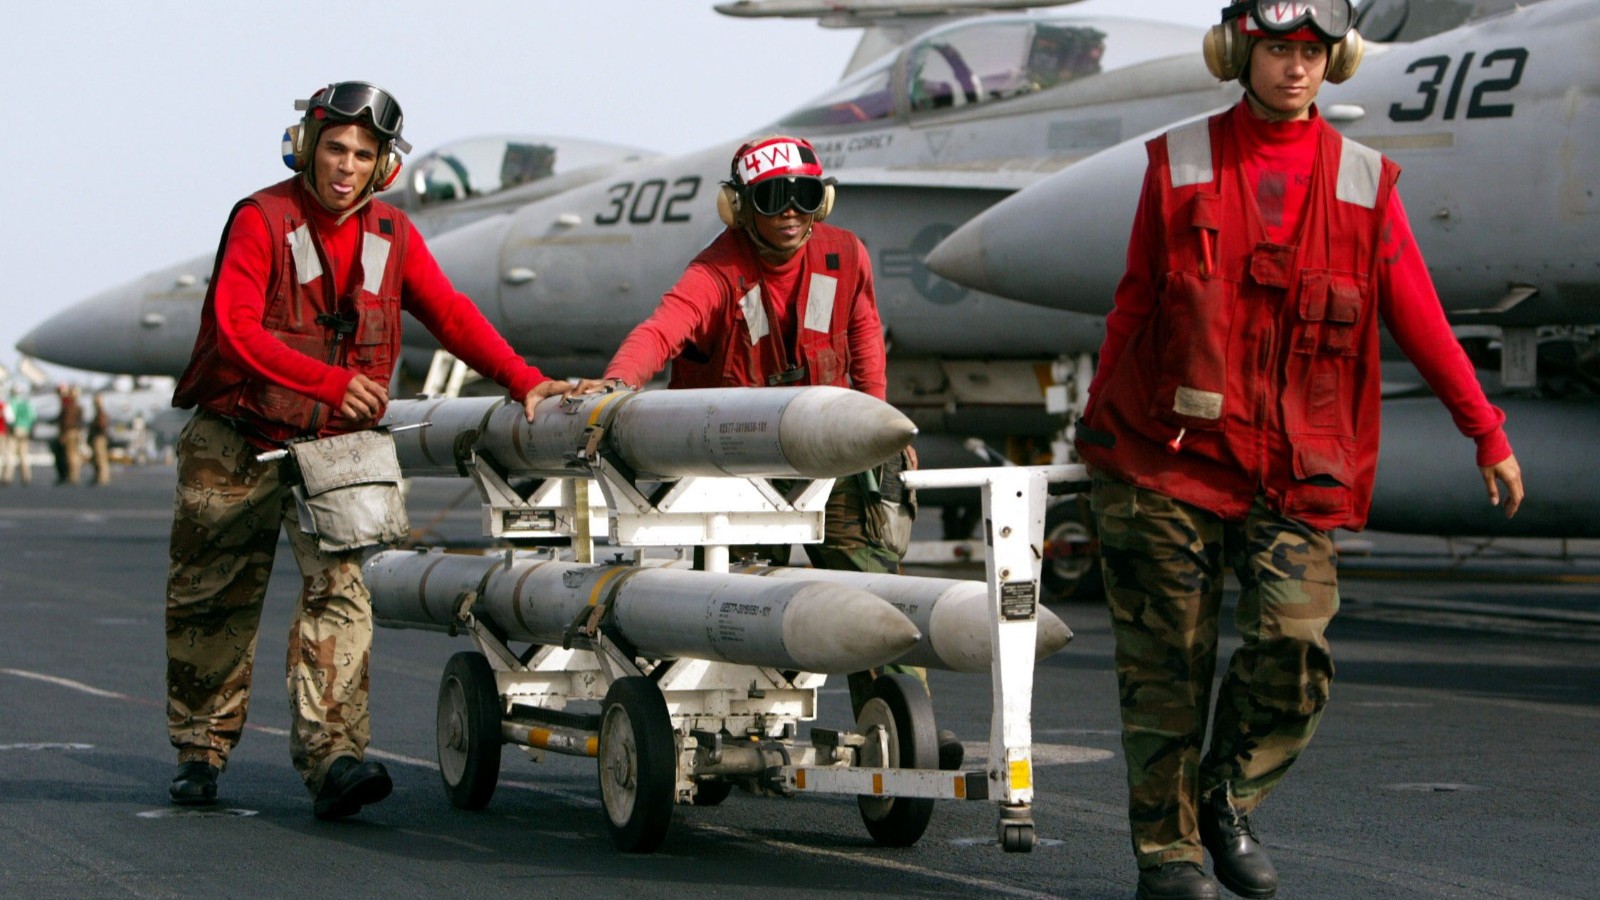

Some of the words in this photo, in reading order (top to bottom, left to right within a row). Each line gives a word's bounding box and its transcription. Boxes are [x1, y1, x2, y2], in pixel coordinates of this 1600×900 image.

[1388, 46, 1530, 123] 312
[744, 144, 790, 174] 4W
[594, 176, 703, 226] 302
